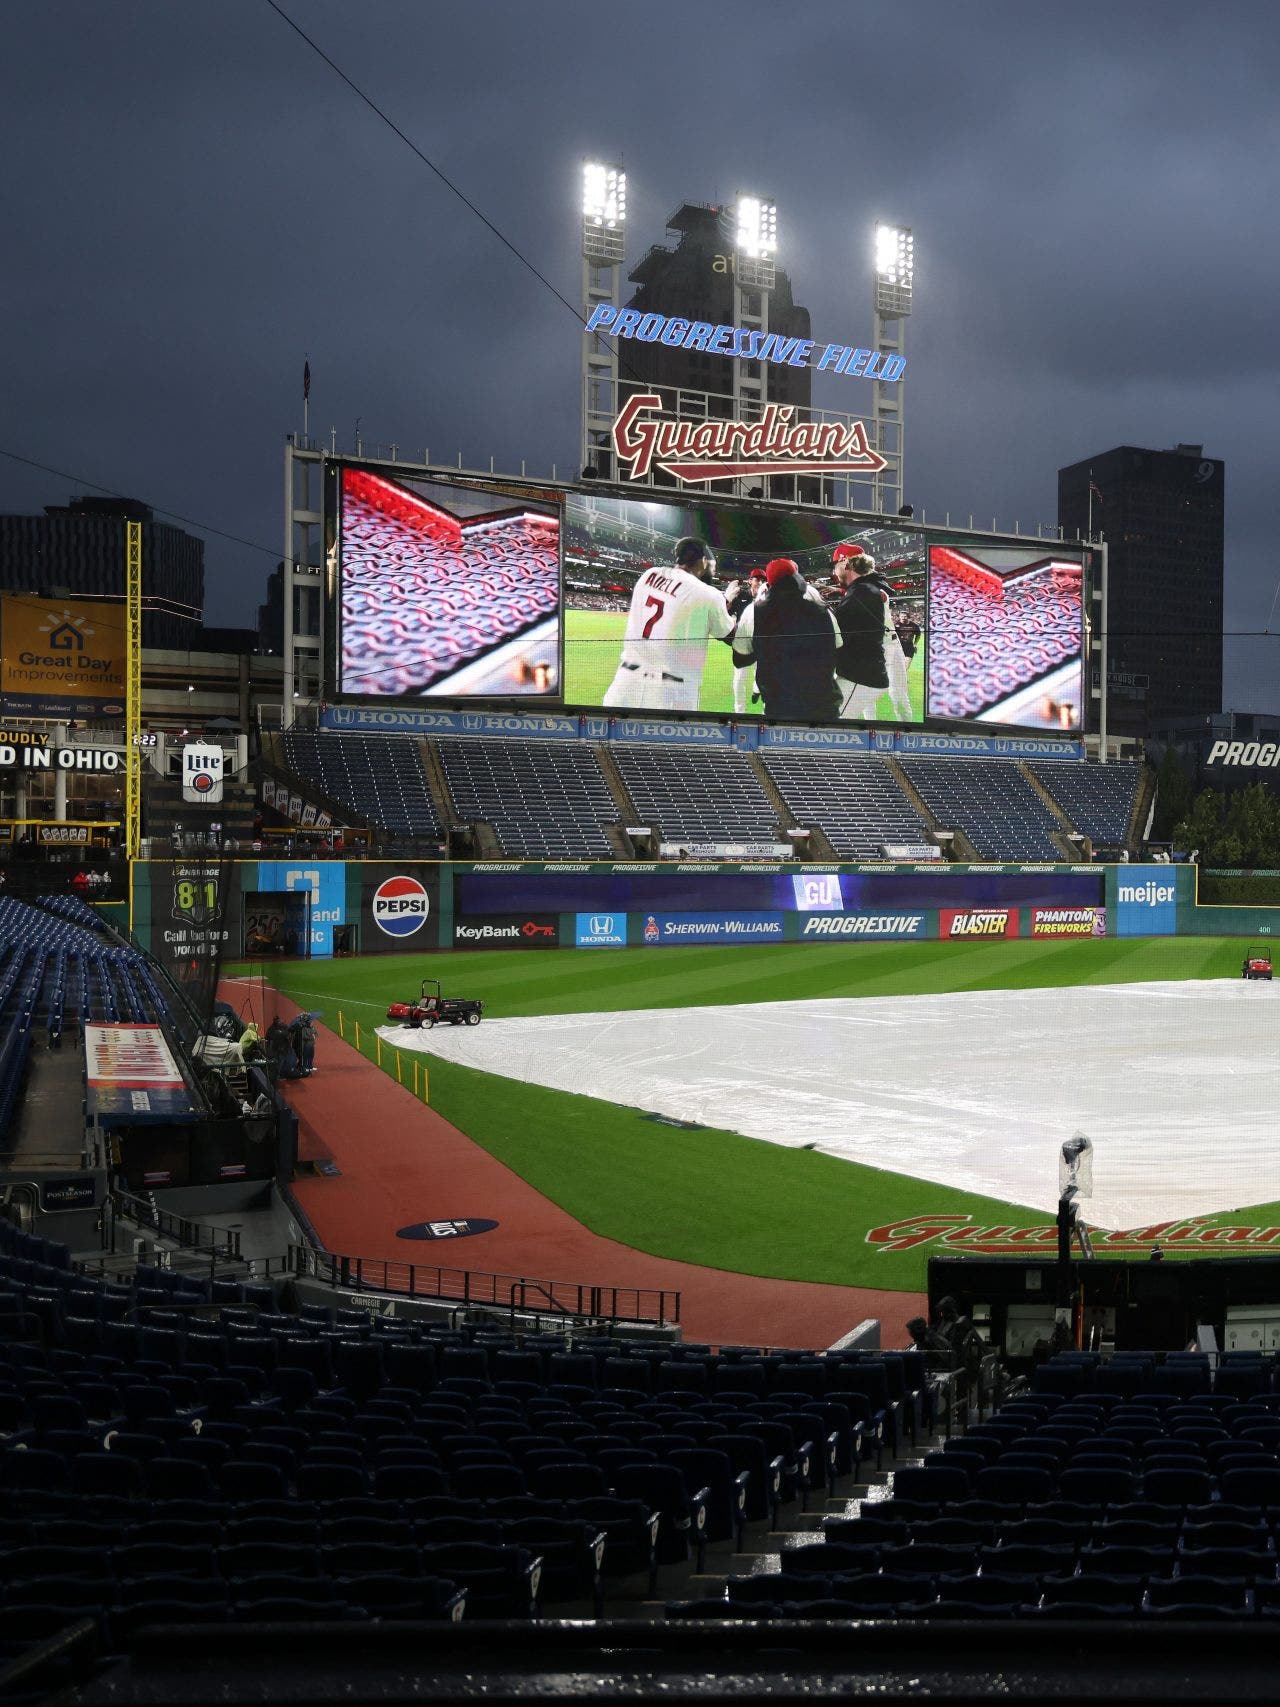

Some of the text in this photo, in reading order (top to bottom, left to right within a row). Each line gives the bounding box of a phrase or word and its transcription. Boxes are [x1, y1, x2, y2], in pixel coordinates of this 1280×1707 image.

[585, 303, 907, 382] PROGRESSIVE FIELD
[613, 394, 888, 482] Guardians
[642, 596, 665, 638] 7
[19, 652, 112, 672] Great Day
[8, 668, 122, 684] Improvements
[358, 712, 455, 727] HONDA
[485, 716, 575, 732] HONDA
[643, 723, 725, 739] HONDA
[798, 731, 863, 745] HONDA
[920, 737, 989, 751] HONDA
[1010, 741, 1076, 754] HONDA
[24, 748, 51, 767] IN
[58, 749, 119, 770] OHIO
[187, 754, 220, 772] Lite
[1118, 881, 1174, 907] meijer
[376, 900, 426, 913] PEPSI
[950, 914, 1008, 935] BLASTER
[1035, 911, 1093, 922] PHANTOM
[456, 925, 520, 939] KeyBank
[804, 917, 921, 933] PROGRESSIVE
[1034, 923, 1092, 933] FIREWORKS
